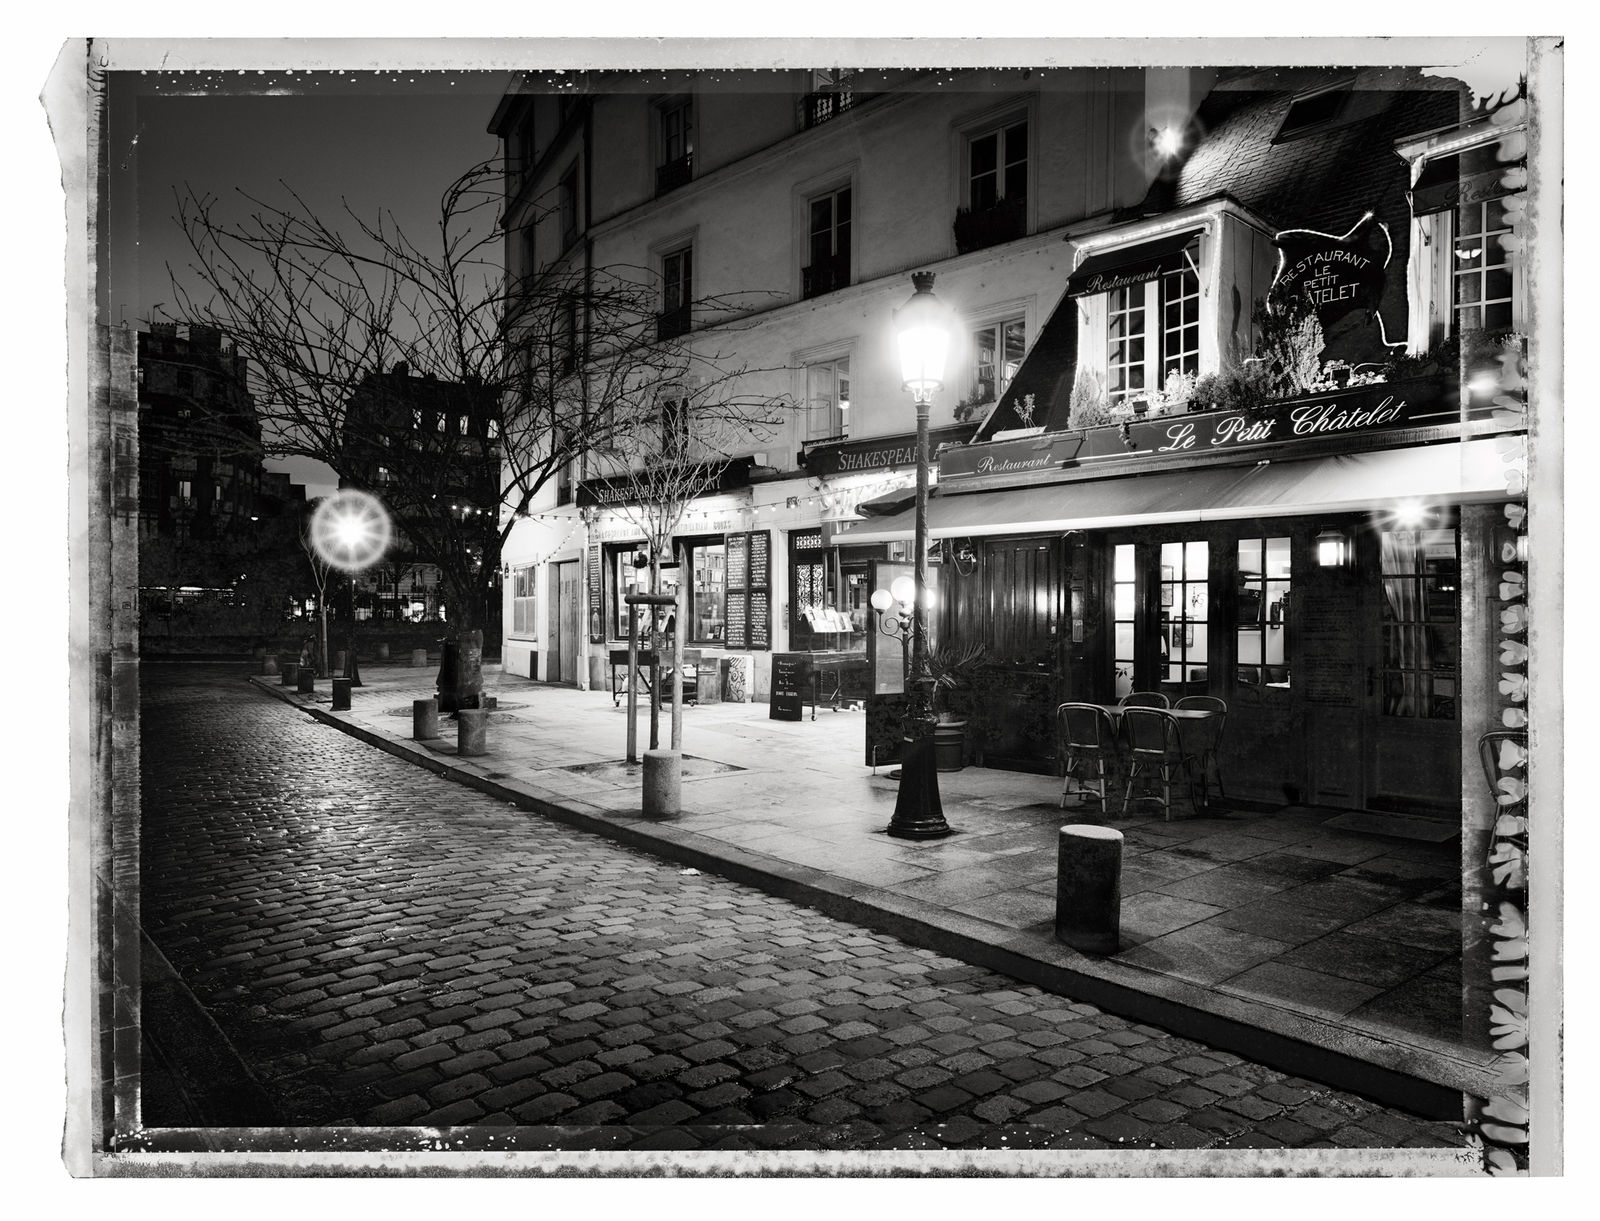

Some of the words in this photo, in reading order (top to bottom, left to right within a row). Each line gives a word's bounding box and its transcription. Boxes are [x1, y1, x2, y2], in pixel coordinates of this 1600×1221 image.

[1086, 264, 1162, 293] Restaurant
[1280, 250, 1371, 286] RESTAURANT
[1314, 264, 1331, 277] LE
[1303, 275, 1339, 289] PETIT
[1157, 423, 1197, 453] Le
[1210, 416, 1277, 446] Petit
[1289, 395, 1407, 436] Châtelet
[976, 454, 1051, 474] Restaurant
